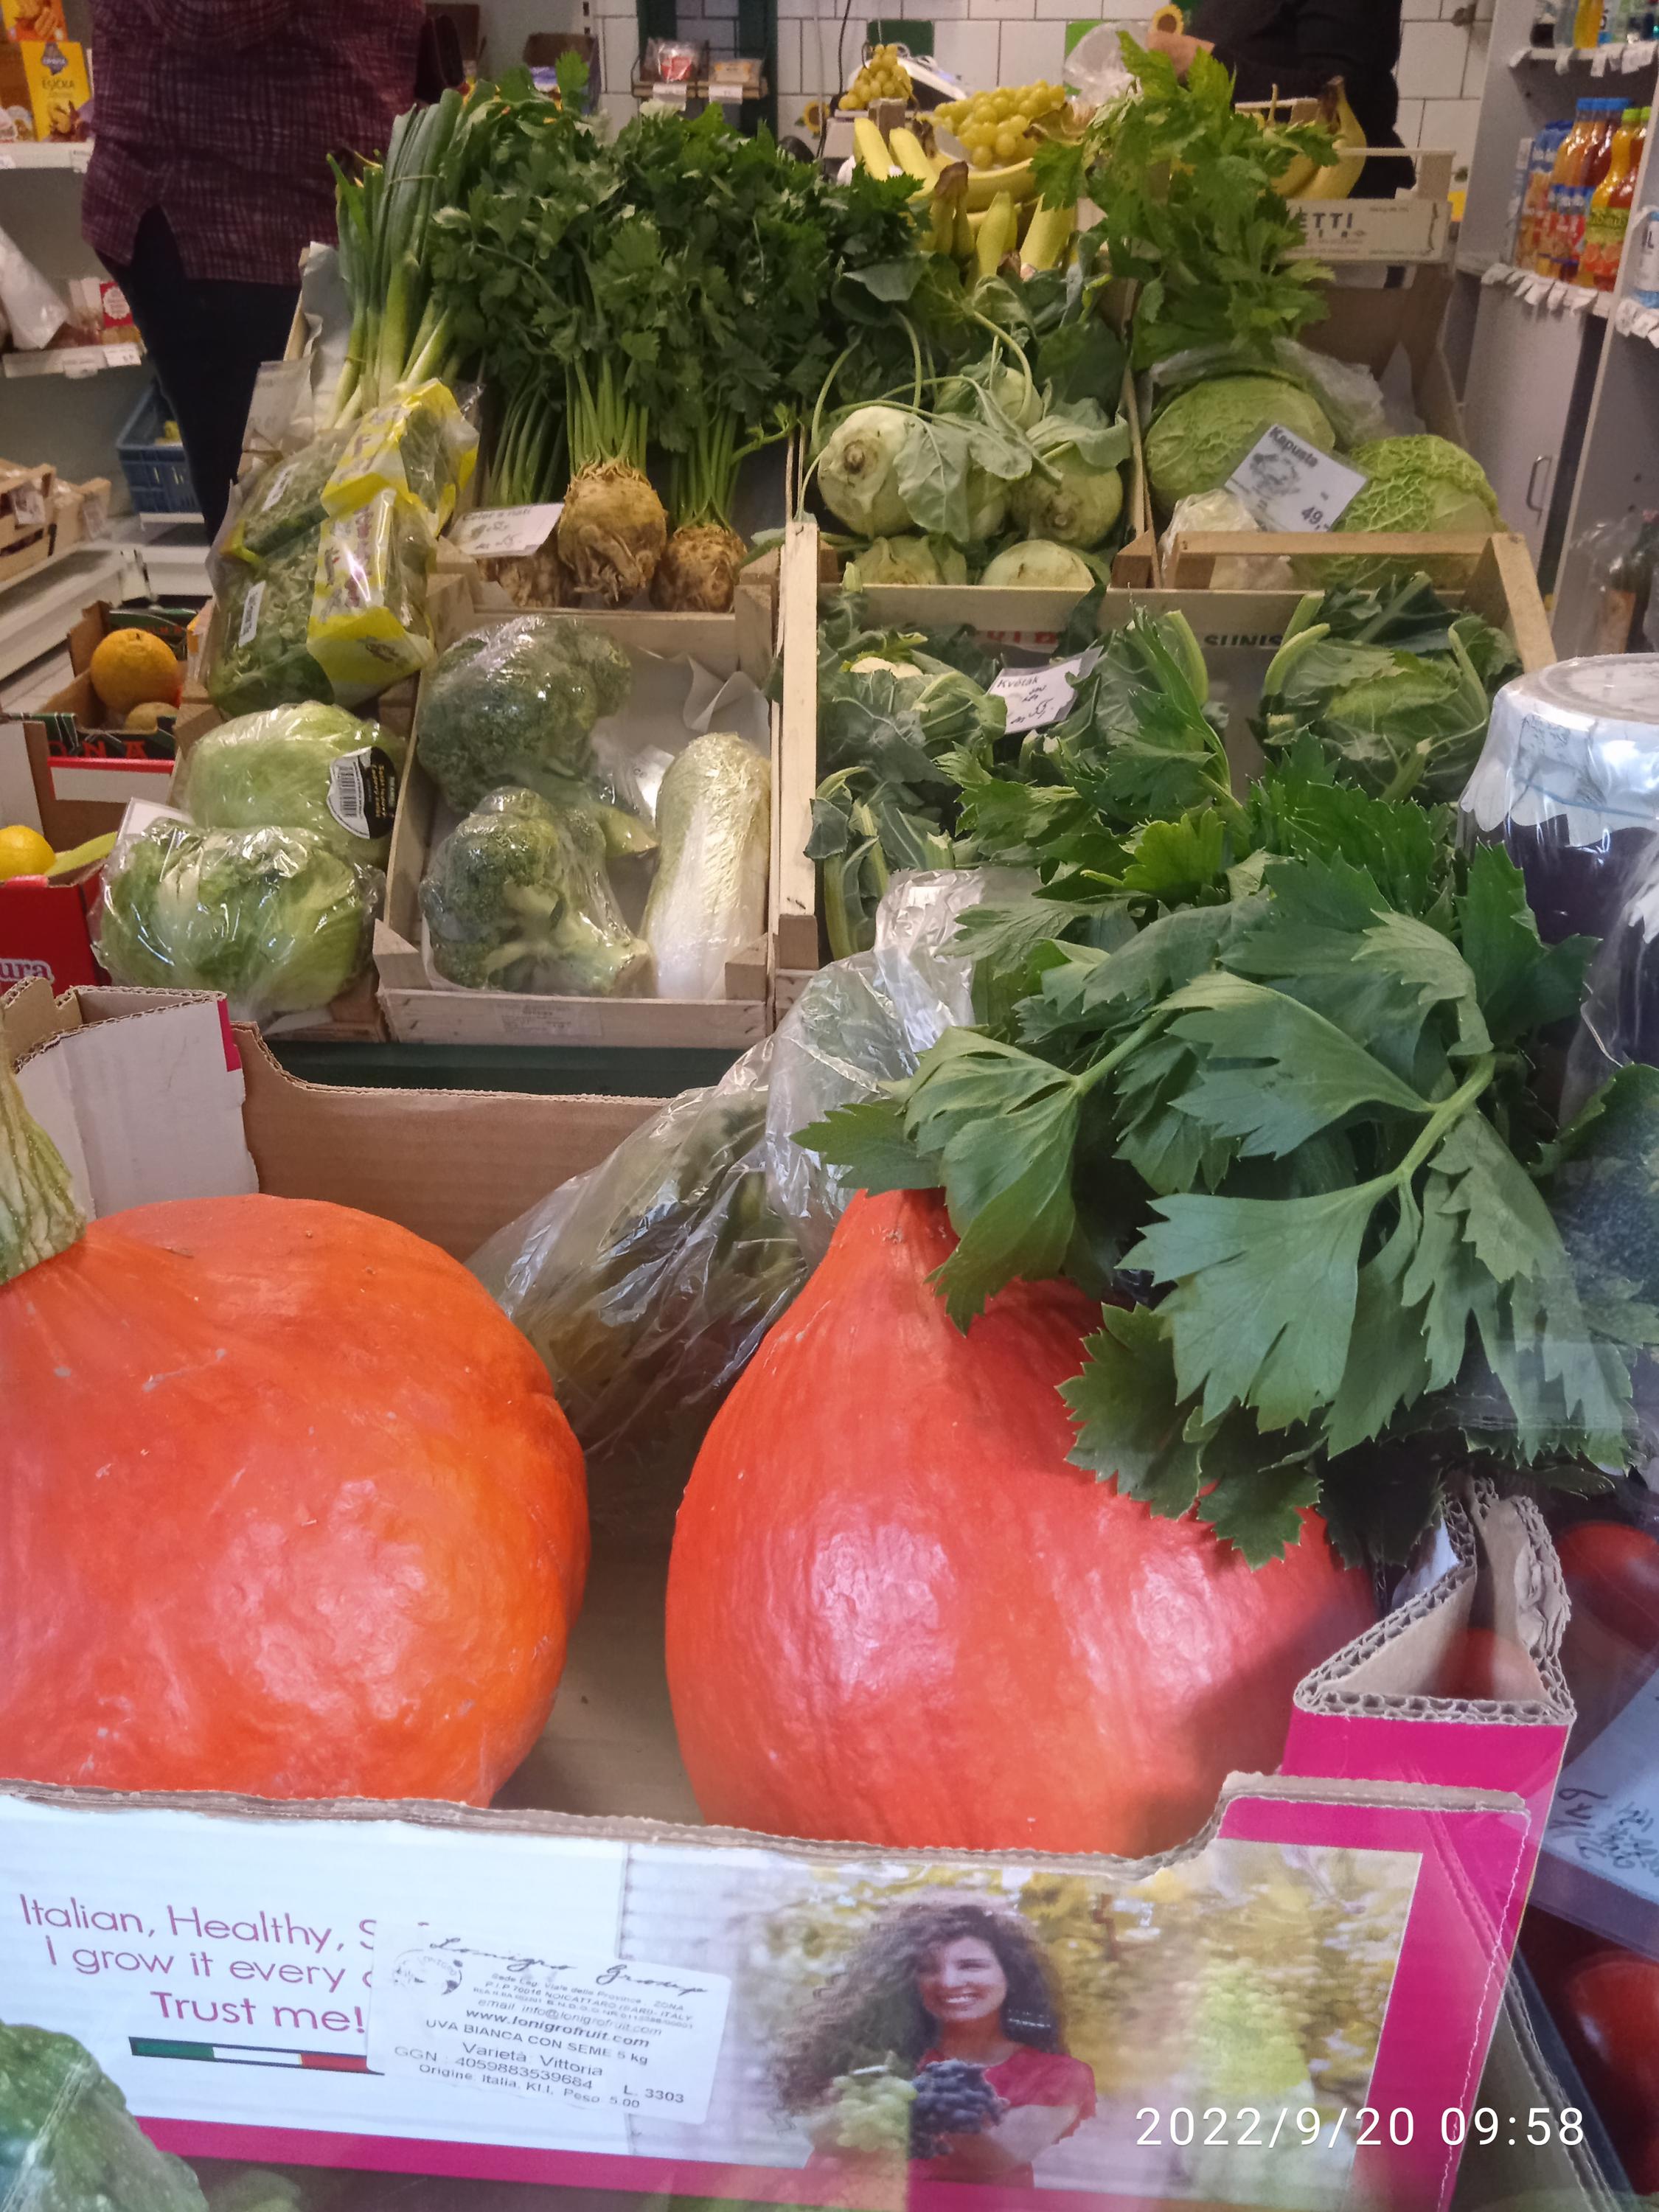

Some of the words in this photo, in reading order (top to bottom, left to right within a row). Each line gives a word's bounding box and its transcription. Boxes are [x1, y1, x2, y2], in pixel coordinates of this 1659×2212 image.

[1269, 426, 1318, 467] Kapusta
[20, 1893, 154, 1938] Italian,
[167, 1905, 344, 1953] Healthy,
[46, 1935, 56, 1966] I
[72, 1949, 174, 1975] grow
[189, 1952, 213, 1977] it
[229, 1960, 346, 1993] every
[150, 1992, 256, 2025] Trust
[273, 2006, 365, 2034] me!
[466, 2009, 650, 2048] www.lonigrofruit.com
[425, 2019, 459, 2031] UVA
[463, 2023, 523, 2042] BIANCA
[528, 2035, 563, 2049] CON
[567, 2042, 611, 2057] SEME
[631, 2053, 648, 2067] kg
[540, 2054, 603, 2076] Vittoria
[394, 2045, 437, 2062] GGN
[644, 2088, 684, 2104] 3303
